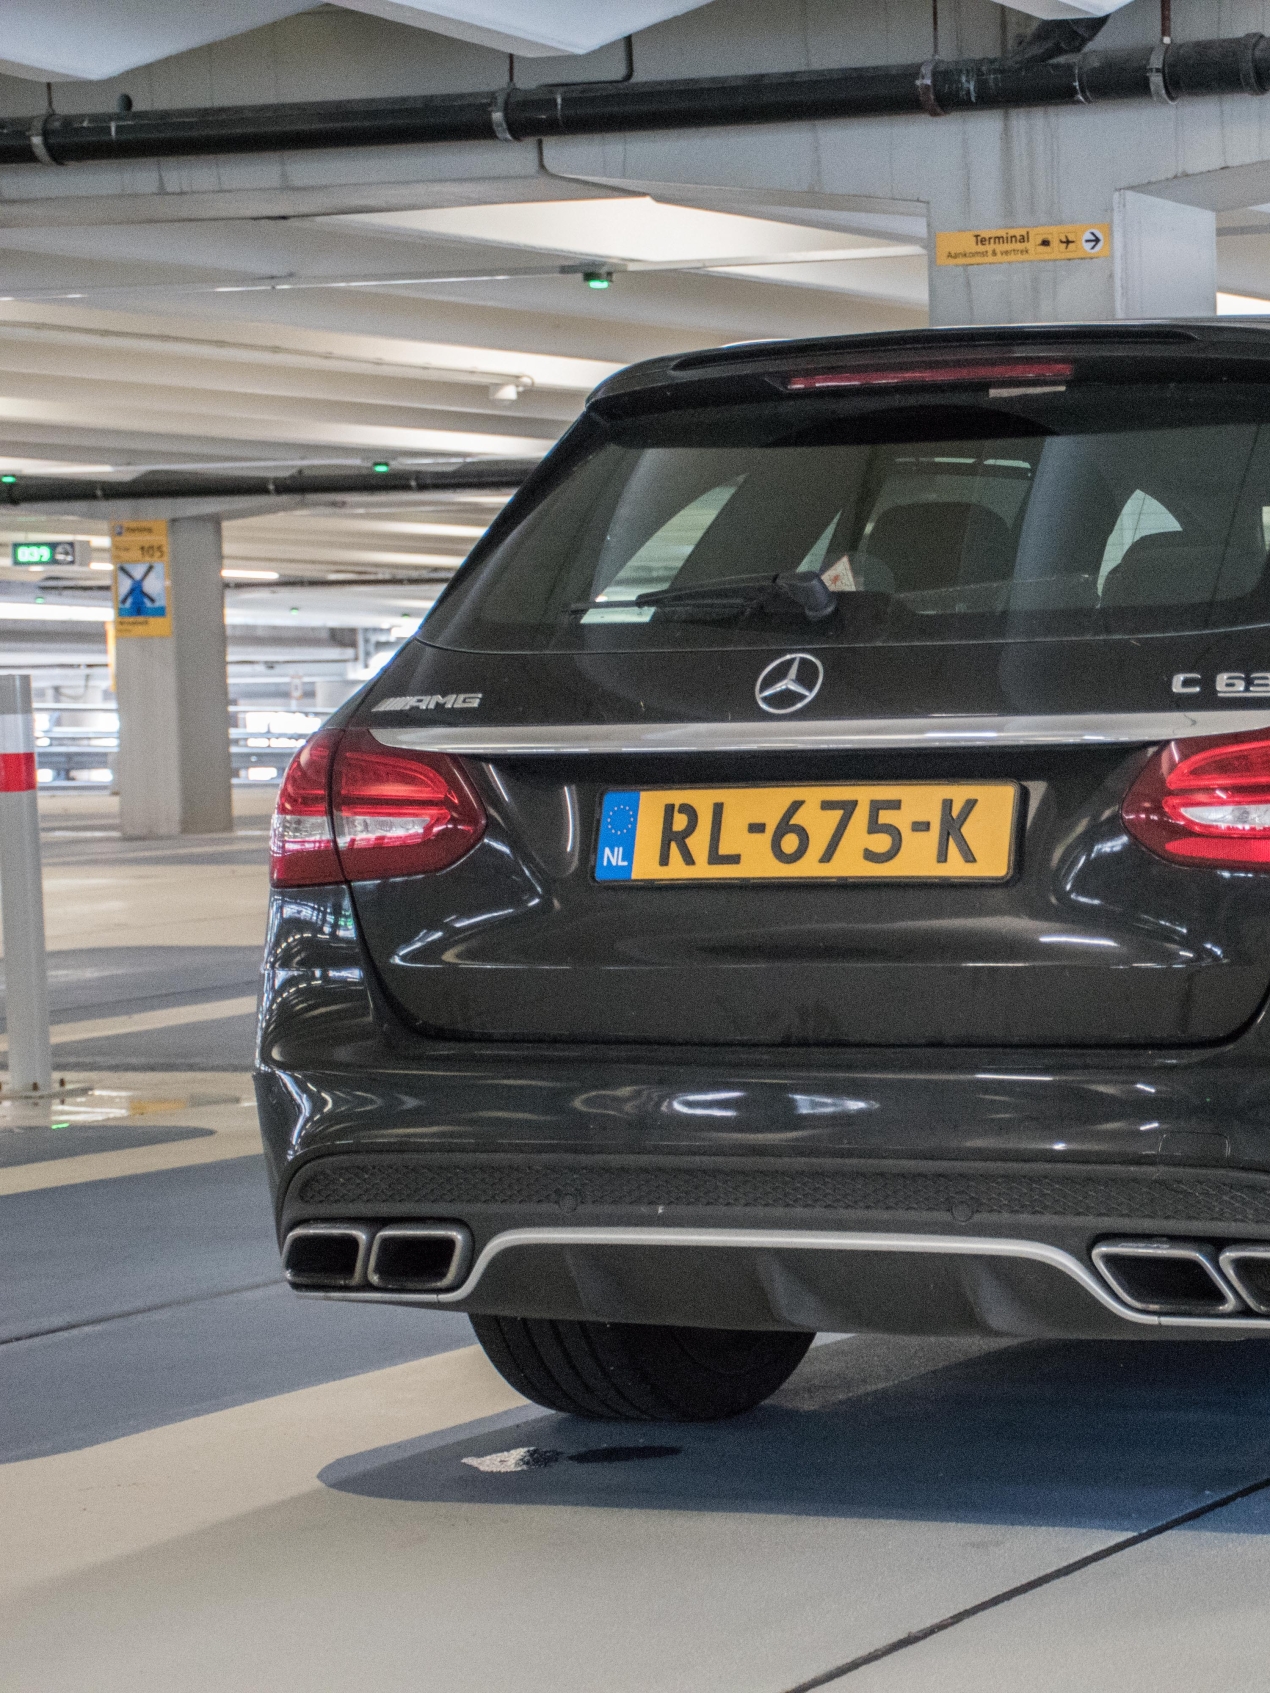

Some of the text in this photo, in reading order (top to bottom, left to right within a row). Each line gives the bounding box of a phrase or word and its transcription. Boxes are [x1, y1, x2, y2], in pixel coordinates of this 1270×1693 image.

[973, 231, 1030, 246] Terminal
[947, 247, 1030, 260] Aankomst & vertrek
[139, 544, 164, 559] 105
[1172, 673, 1201, 693] C
[396, 693, 483, 711] AMG
[658, 798, 979, 867] RL-675-K
[603, 846, 629, 867] NL
